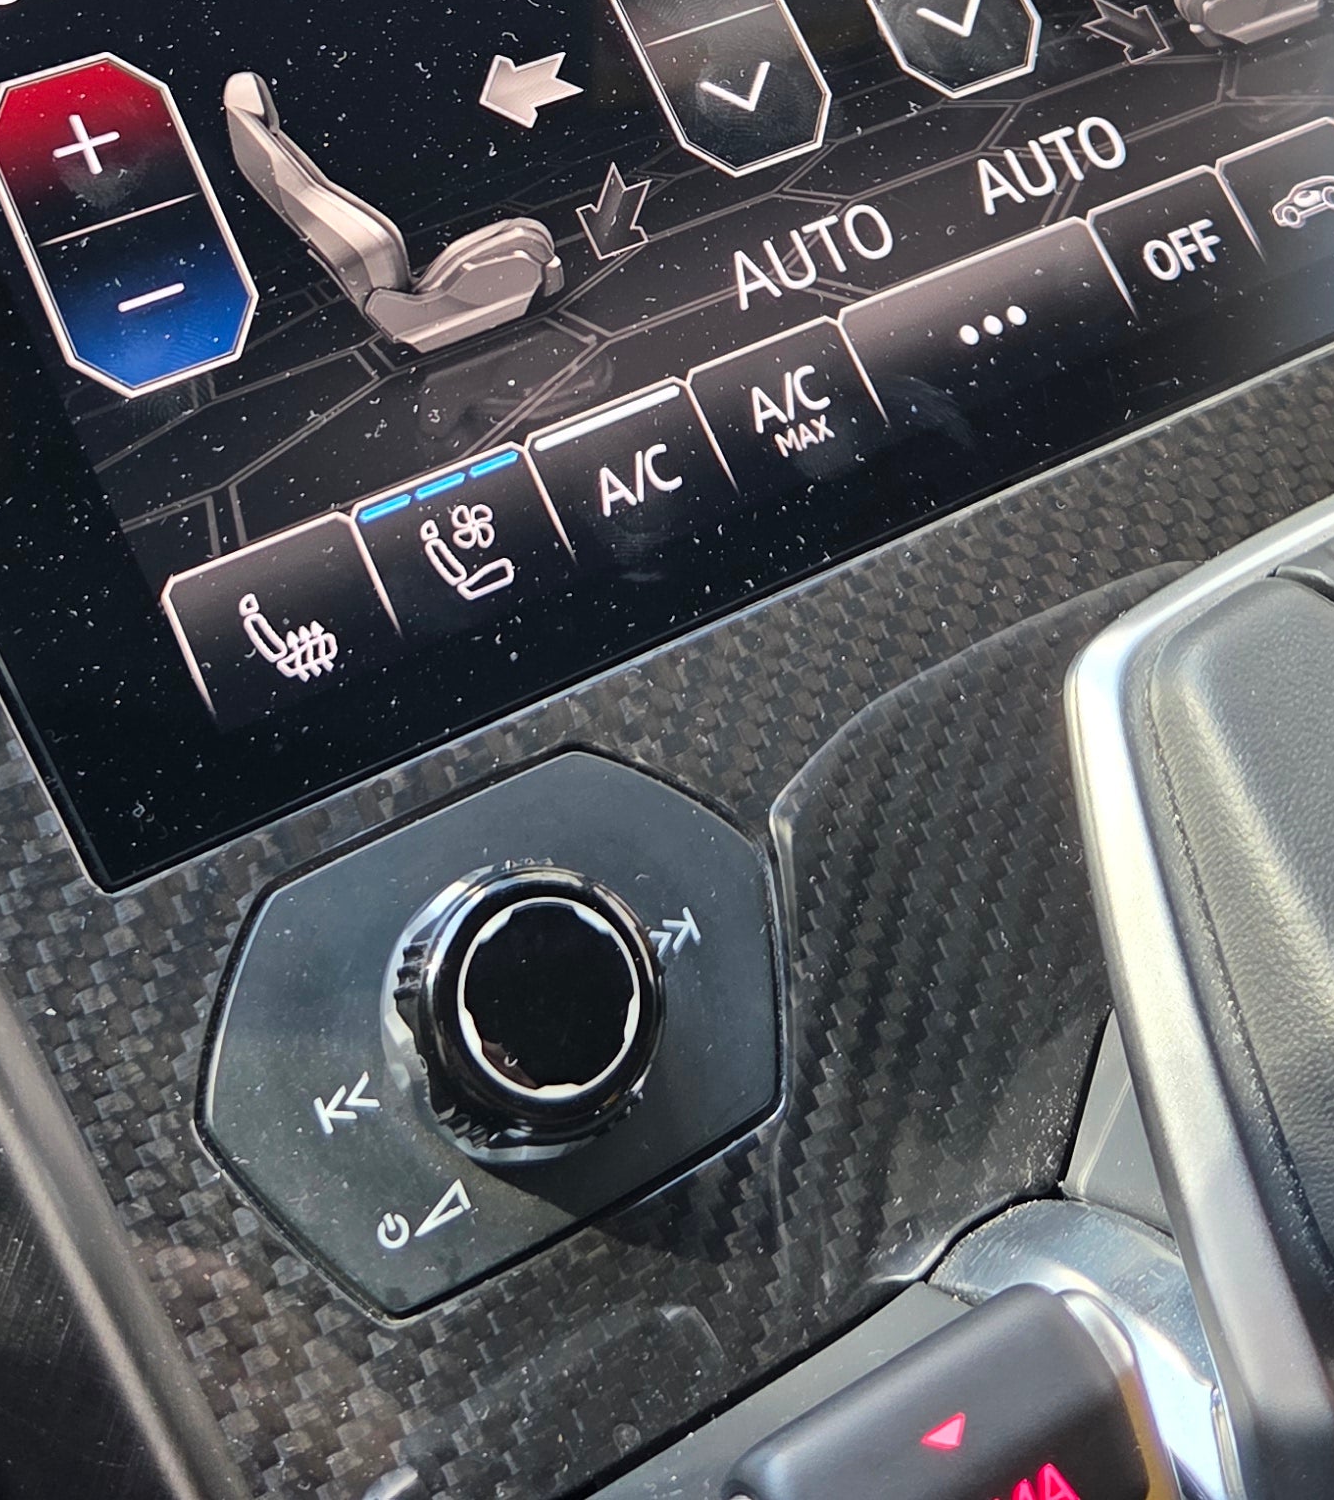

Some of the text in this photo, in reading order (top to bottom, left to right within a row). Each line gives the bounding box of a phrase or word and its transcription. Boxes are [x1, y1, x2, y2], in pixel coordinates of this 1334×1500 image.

[977, 116, 1126, 216] AUTO
[733, 204, 894, 312] AUTO
[1142, 218, 1221, 281] OFF
[751, 364, 831, 434] A/C
[773, 414, 836, 458] MAX
[599, 443, 683, 517] A/C
